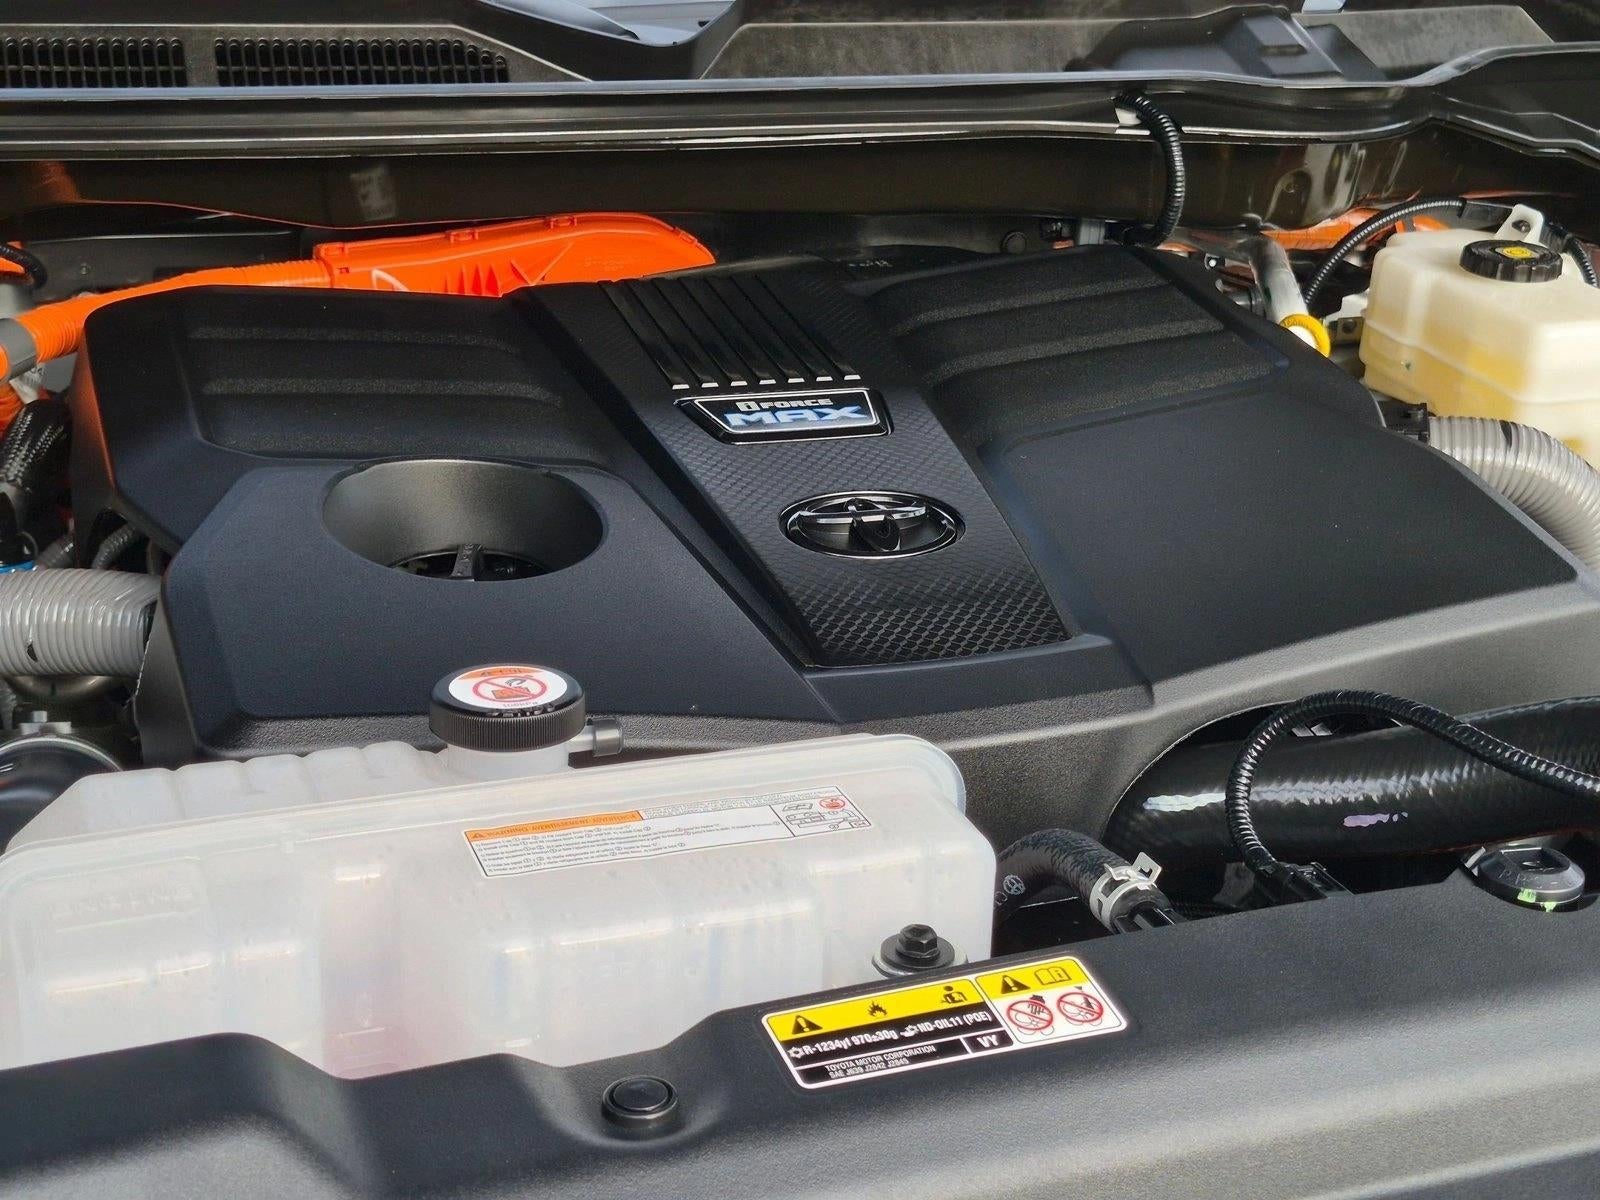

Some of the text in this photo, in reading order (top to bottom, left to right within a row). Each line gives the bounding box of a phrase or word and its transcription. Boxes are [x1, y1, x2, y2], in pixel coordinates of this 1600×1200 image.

[724, 405, 869, 427] MAX
[916, 1015, 963, 1032] ND-OIL11
[962, 1010, 993, 1027] (POE)
[976, 1034, 1000, 1048] VY
[824, 1044, 937, 1073] TOYOTA MOTOR CORPORATION
[828, 1069, 845, 1079] SAE
